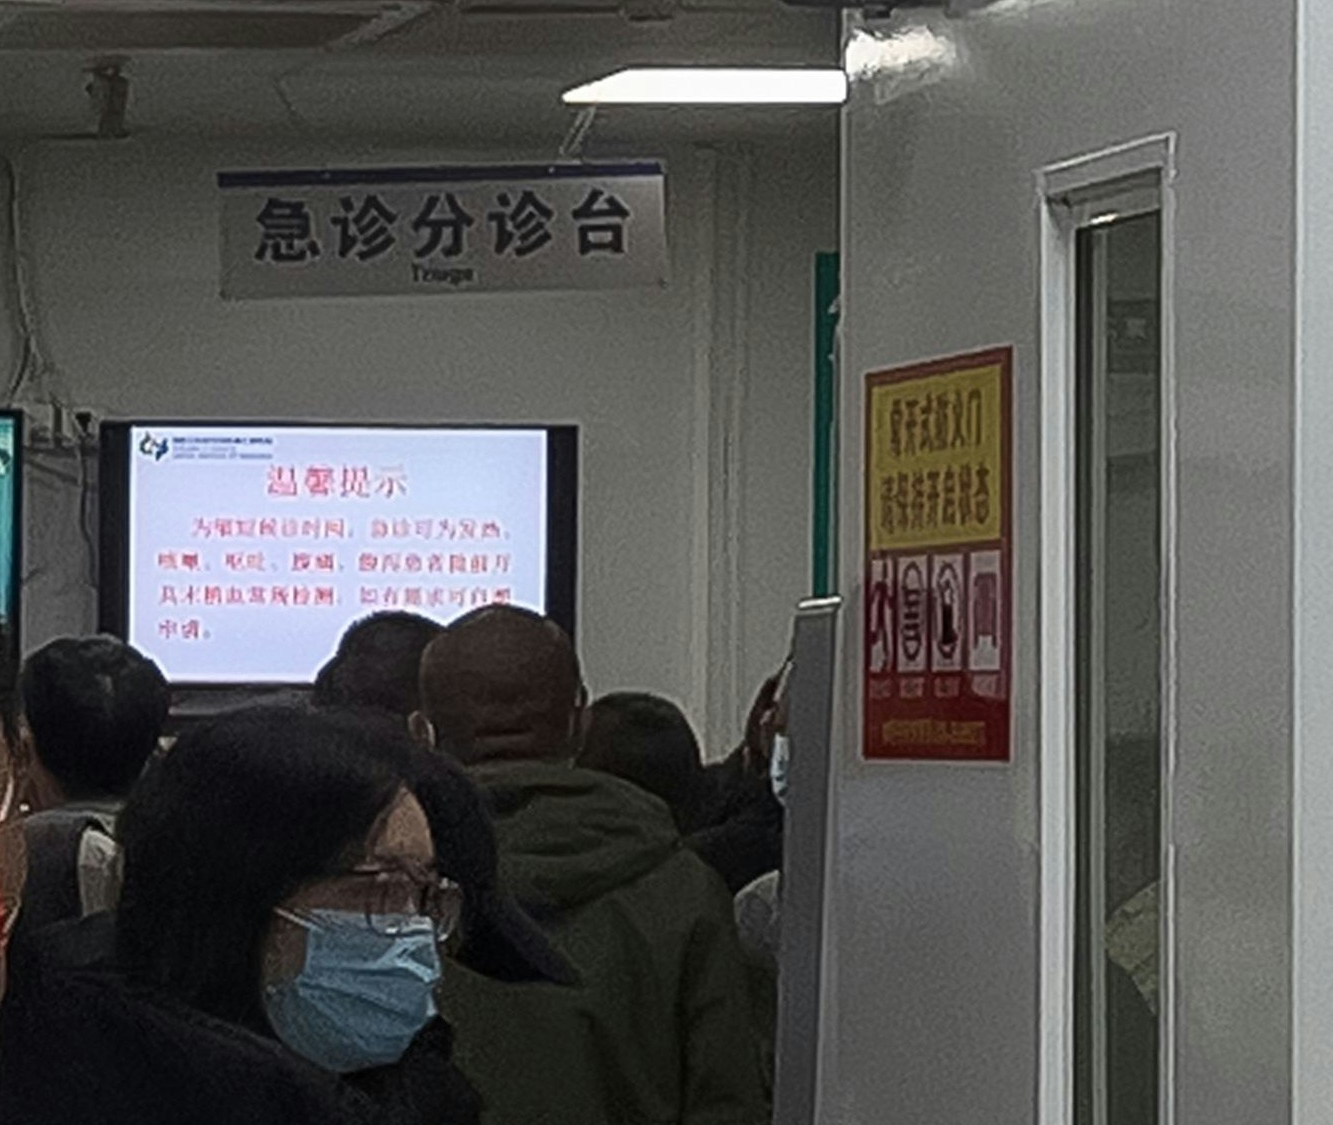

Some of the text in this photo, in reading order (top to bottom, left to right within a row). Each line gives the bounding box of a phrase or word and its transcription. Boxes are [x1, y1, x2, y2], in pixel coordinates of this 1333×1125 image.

[254, 189, 630, 262] 急诊分诊台
[267, 465, 407, 498] 温馨提示
